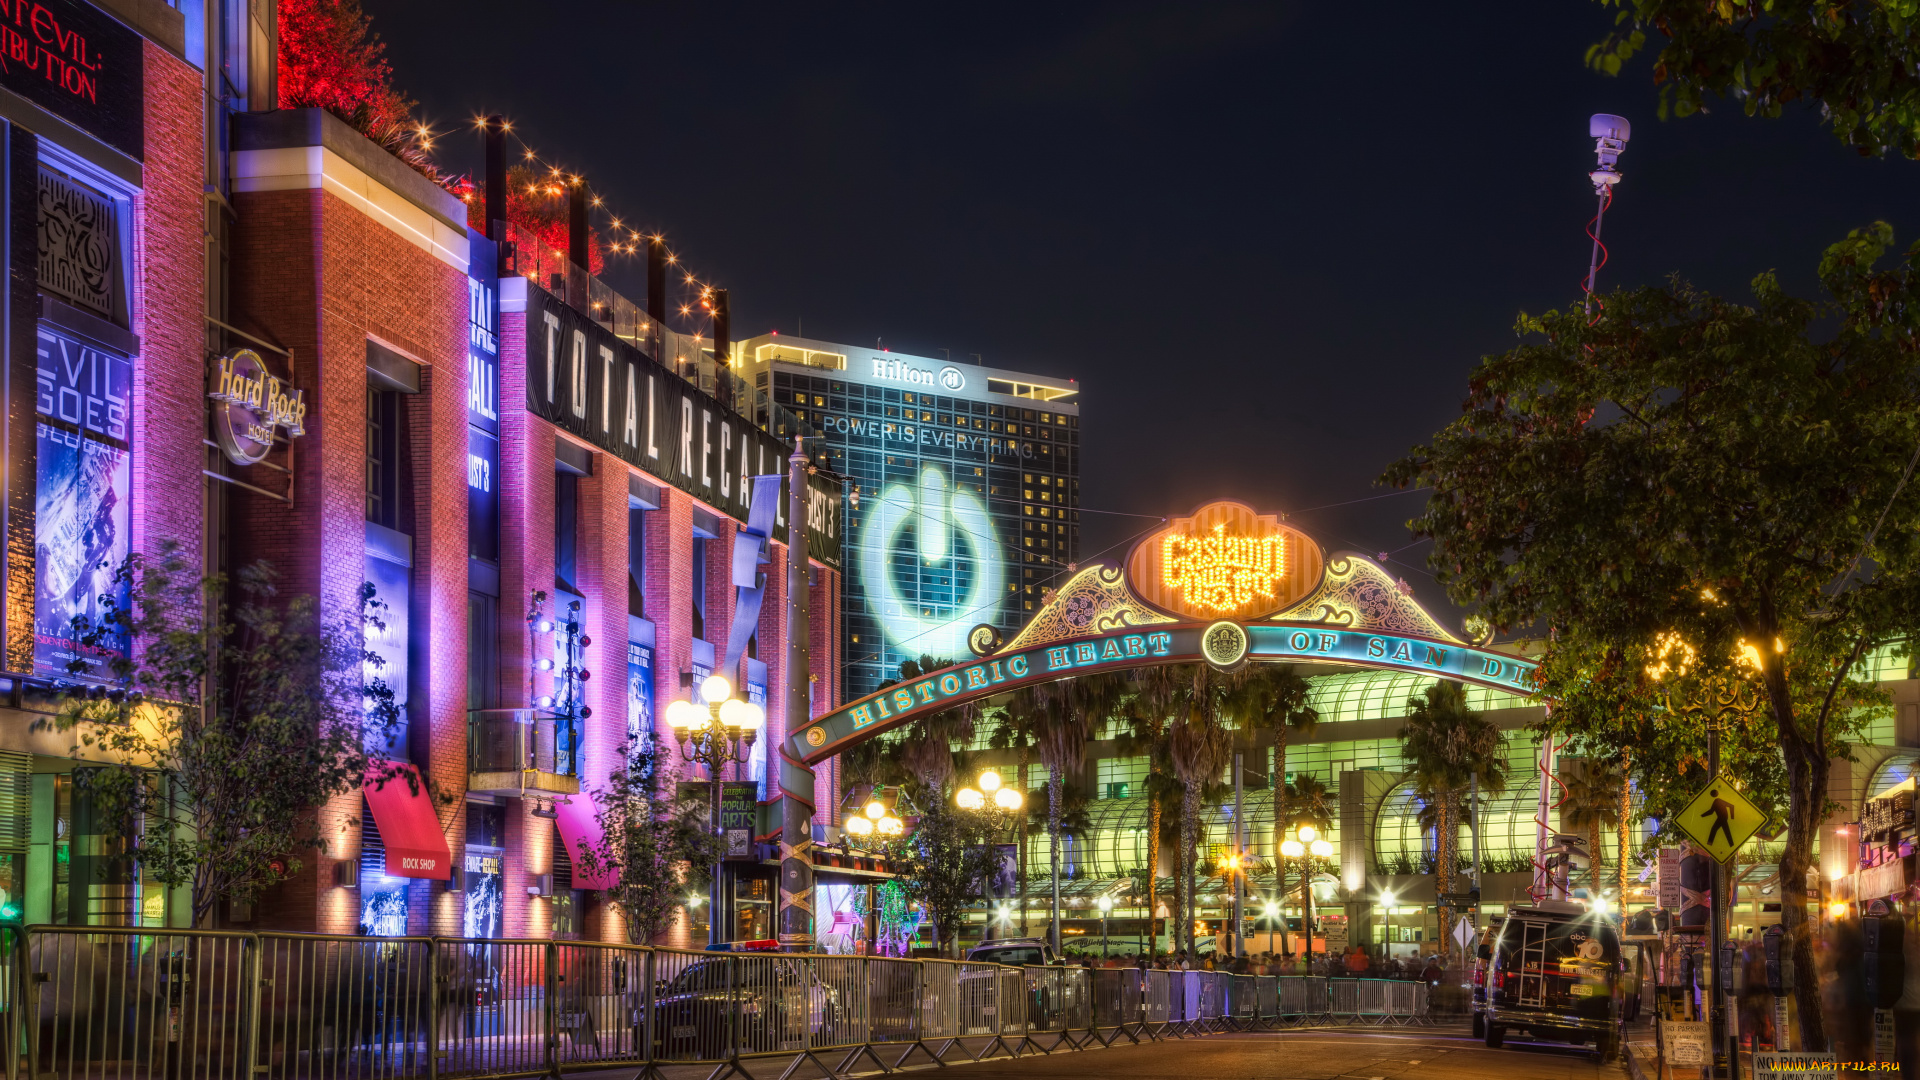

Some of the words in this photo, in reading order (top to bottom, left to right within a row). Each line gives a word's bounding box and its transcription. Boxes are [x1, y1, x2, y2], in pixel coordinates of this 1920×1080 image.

[30, 2, 102, 71] EVIL:
[543, 309, 659, 460] TOTAL
[872, 356, 935, 386] Hilton
[219, 356, 265, 407] Hard
[267, 376, 306, 435] Rock
[247, 422, 275, 445] HOTEL
[823, 415, 893, 440] POWER
[898, 425, 915, 442] IS
[920, 429, 1038, 460] EVERYTHING.
[483, 459, 490, 493] 3
[851, 656, 1029, 729] HISTORIC
[1048, 633, 1170, 668] HEART
[1290, 631, 1337, 653] OF
[1367, 637, 1448, 668] SAN
[1480, 656, 1528, 685] DI
[721, 811, 756, 828] ARTS
[402, 857, 419, 870] ROCK
[419, 859, 436, 871] SHOP
[1569, 933, 1586, 941] abc
[1576, 941, 1604, 960] 10
